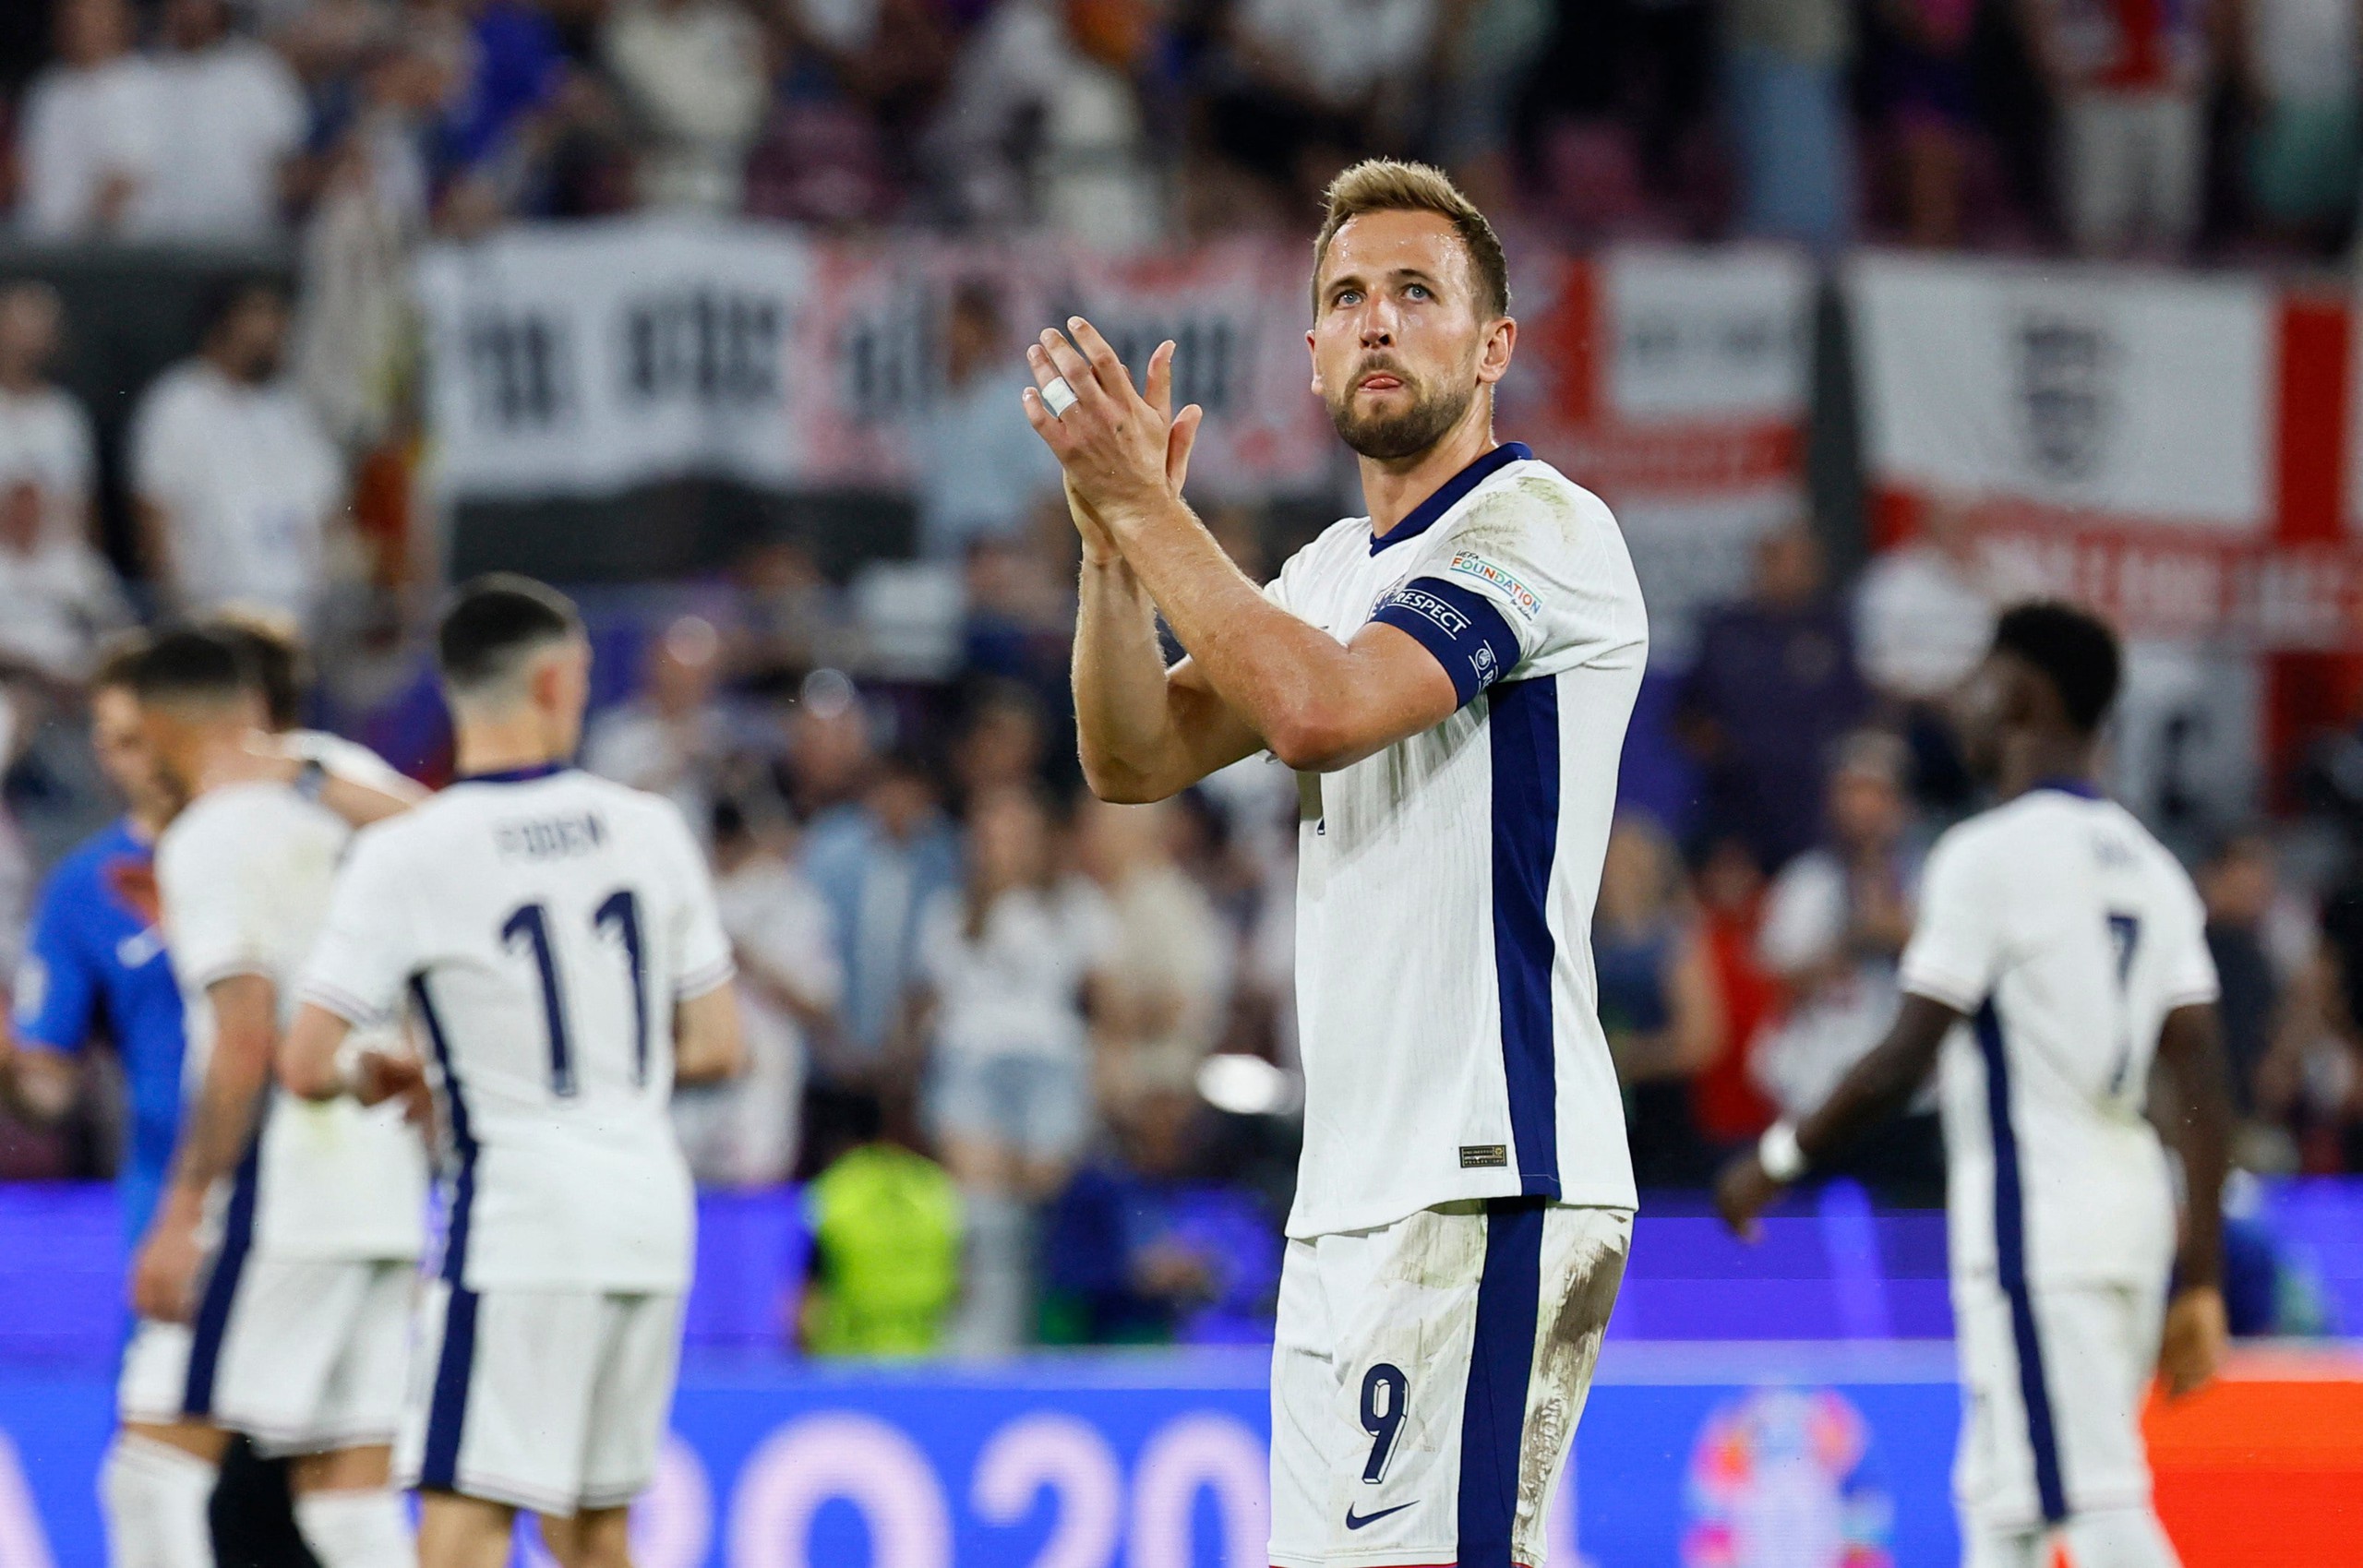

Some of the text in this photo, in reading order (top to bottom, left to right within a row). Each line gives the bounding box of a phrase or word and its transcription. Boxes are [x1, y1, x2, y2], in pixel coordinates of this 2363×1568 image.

[1451, 557, 1541, 614] FOUNDATION
[1456, 550, 1479, 560] UEFA
[1391, 592, 1467, 633] RESPECT
[501, 889, 650, 1097] 11
[2108, 912, 2141, 1095] 7
[1360, 1362, 1410, 1485] 9
